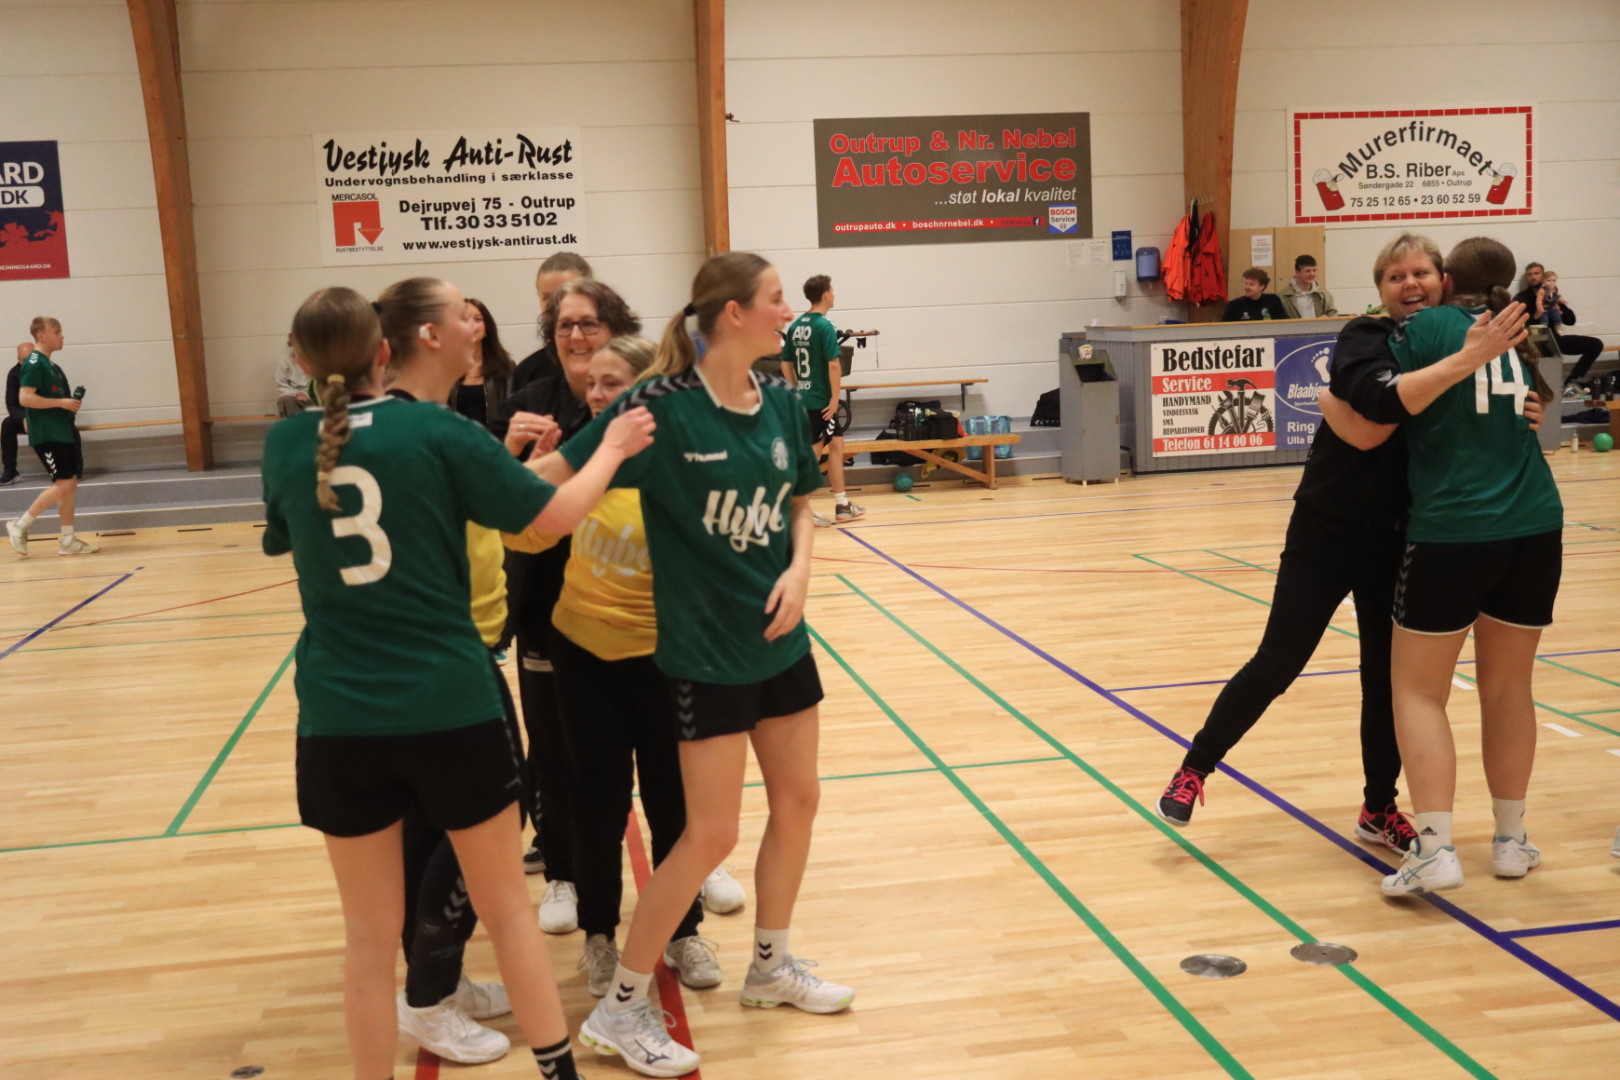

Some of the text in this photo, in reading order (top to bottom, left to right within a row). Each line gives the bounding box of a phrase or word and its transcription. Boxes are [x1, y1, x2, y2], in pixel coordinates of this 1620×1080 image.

[829, 126, 1077, 157] Outrup & Nr. Nebel
[1337, 120, 1494, 179] Murerfirmaet
[322, 133, 573, 177] Vestjysk Anti-Rust
[324, 169, 574, 187] Undervognsbehandling i særklasse
[831, 152, 1078, 188] Autoservice
[1365, 162, 1401, 180] B.S.
[1405, 162, 1452, 178] Riber
[1405, 180, 1415, 189] 22
[1422, 180, 1440, 188] 6855
[1446, 178, 1473, 188] Outrup
[331, 192, 379, 202] MERCASOL
[398, 198, 477, 215] Dejrupvej
[482, 197, 502, 210] 75
[520, 195, 576, 212] Outrup
[934, 186, 1078, 206] ...støt lokal kvalitet
[1350, 193, 1482, 208] 75 25 12 65 23 60 52 59
[1050, 207, 1076, 216] BOSCH
[420, 216, 453, 231] Tlf.
[834, 220, 897, 231] outrupauto.dk
[911, 217, 984, 229] boschnrnebel.dk
[402, 233, 578, 251] www.vestjysk-antirust.dk
[795, 347, 811, 379] 13
[1162, 345, 1265, 372] Bedstefar
[1162, 375, 1213, 393] Service
[1475, 347, 1530, 416] 14
[1162, 394, 1212, 407] HANDYMAND
[1162, 426, 1206, 435] REPARATIONER
[1286, 421, 1315, 434] Ring
[1162, 433, 1264, 452] Telefon 61 14 00 06
[1286, 435, 1305, 445] Ulla
[332, 464, 393, 586] 3
